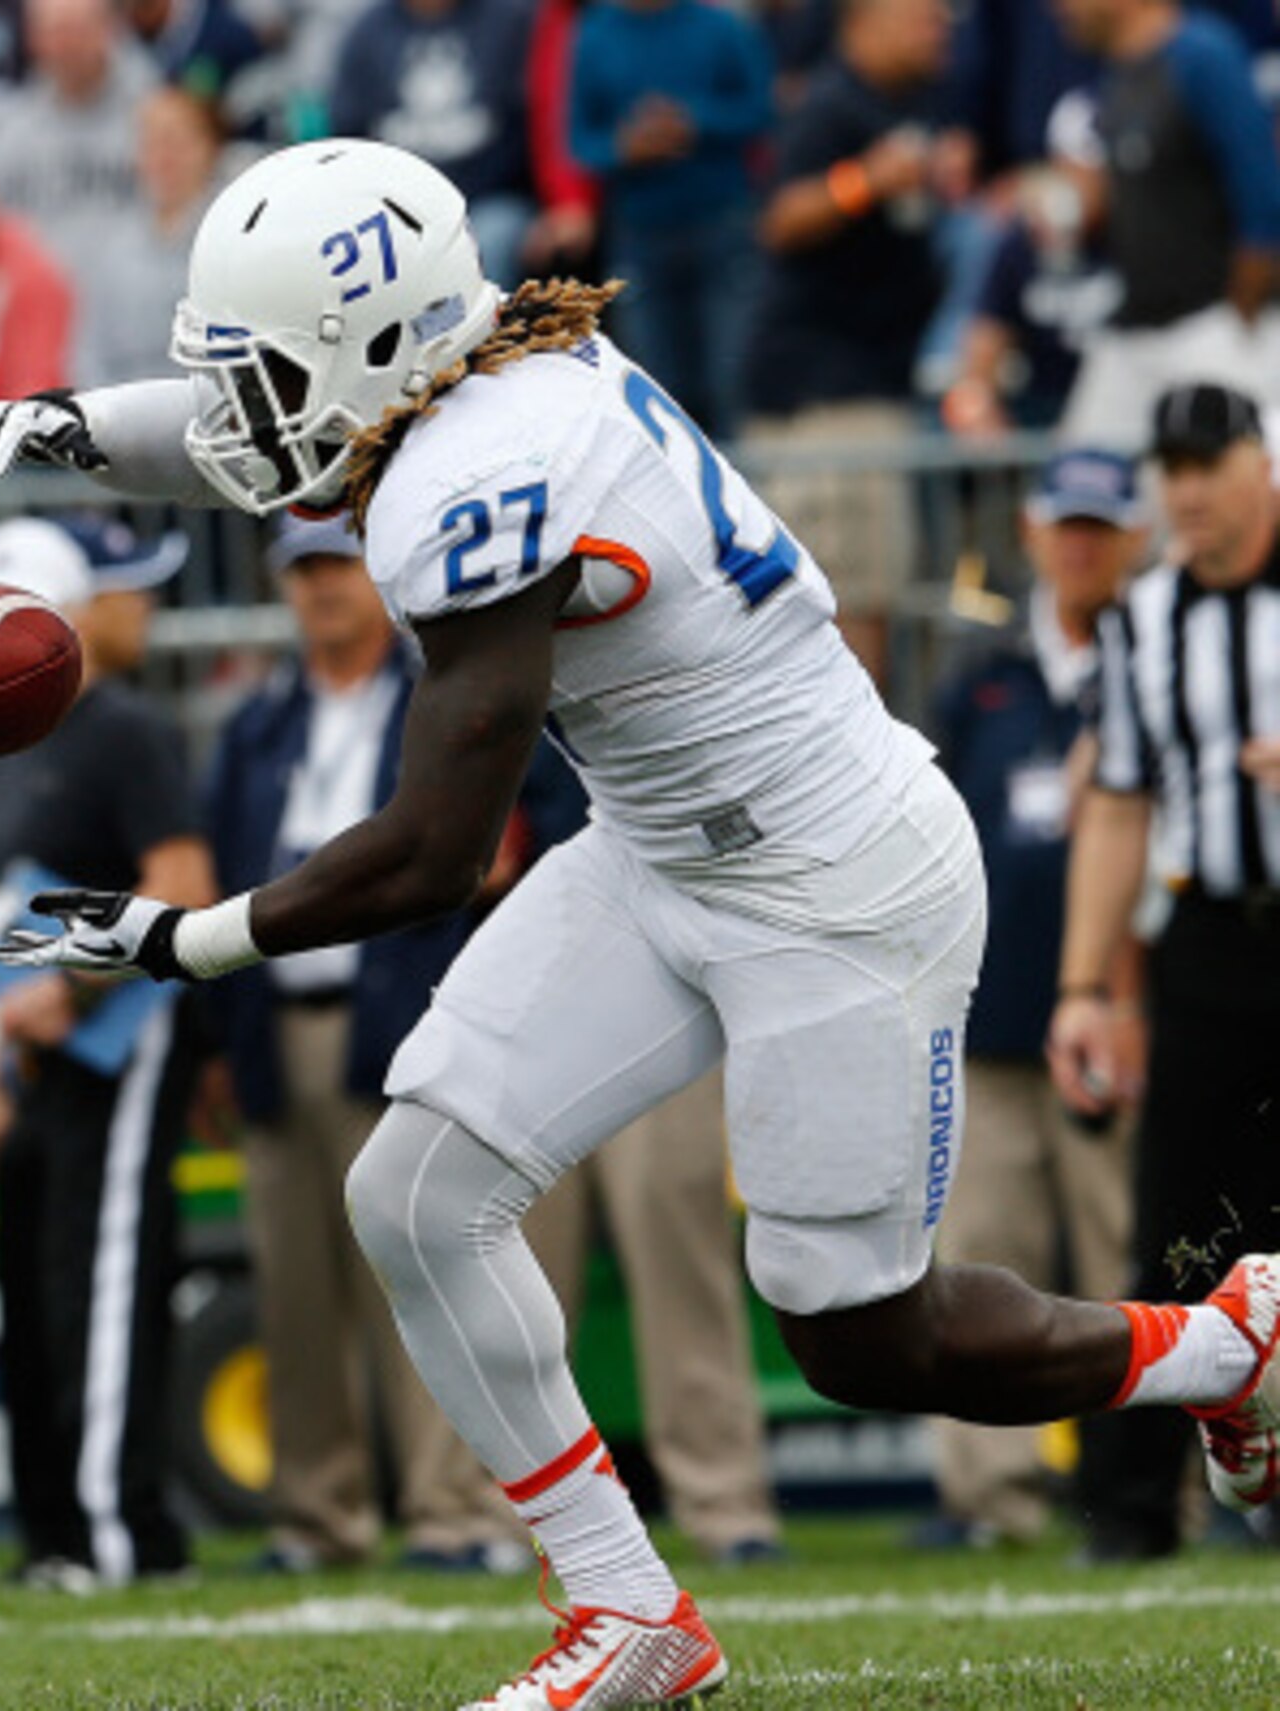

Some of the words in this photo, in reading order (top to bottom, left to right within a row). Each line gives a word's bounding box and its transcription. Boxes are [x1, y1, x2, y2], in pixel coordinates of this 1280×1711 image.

[321, 211, 398, 303] 27
[439, 478, 548, 597] 27
[922, 1026, 954, 1231] BRONCOS
